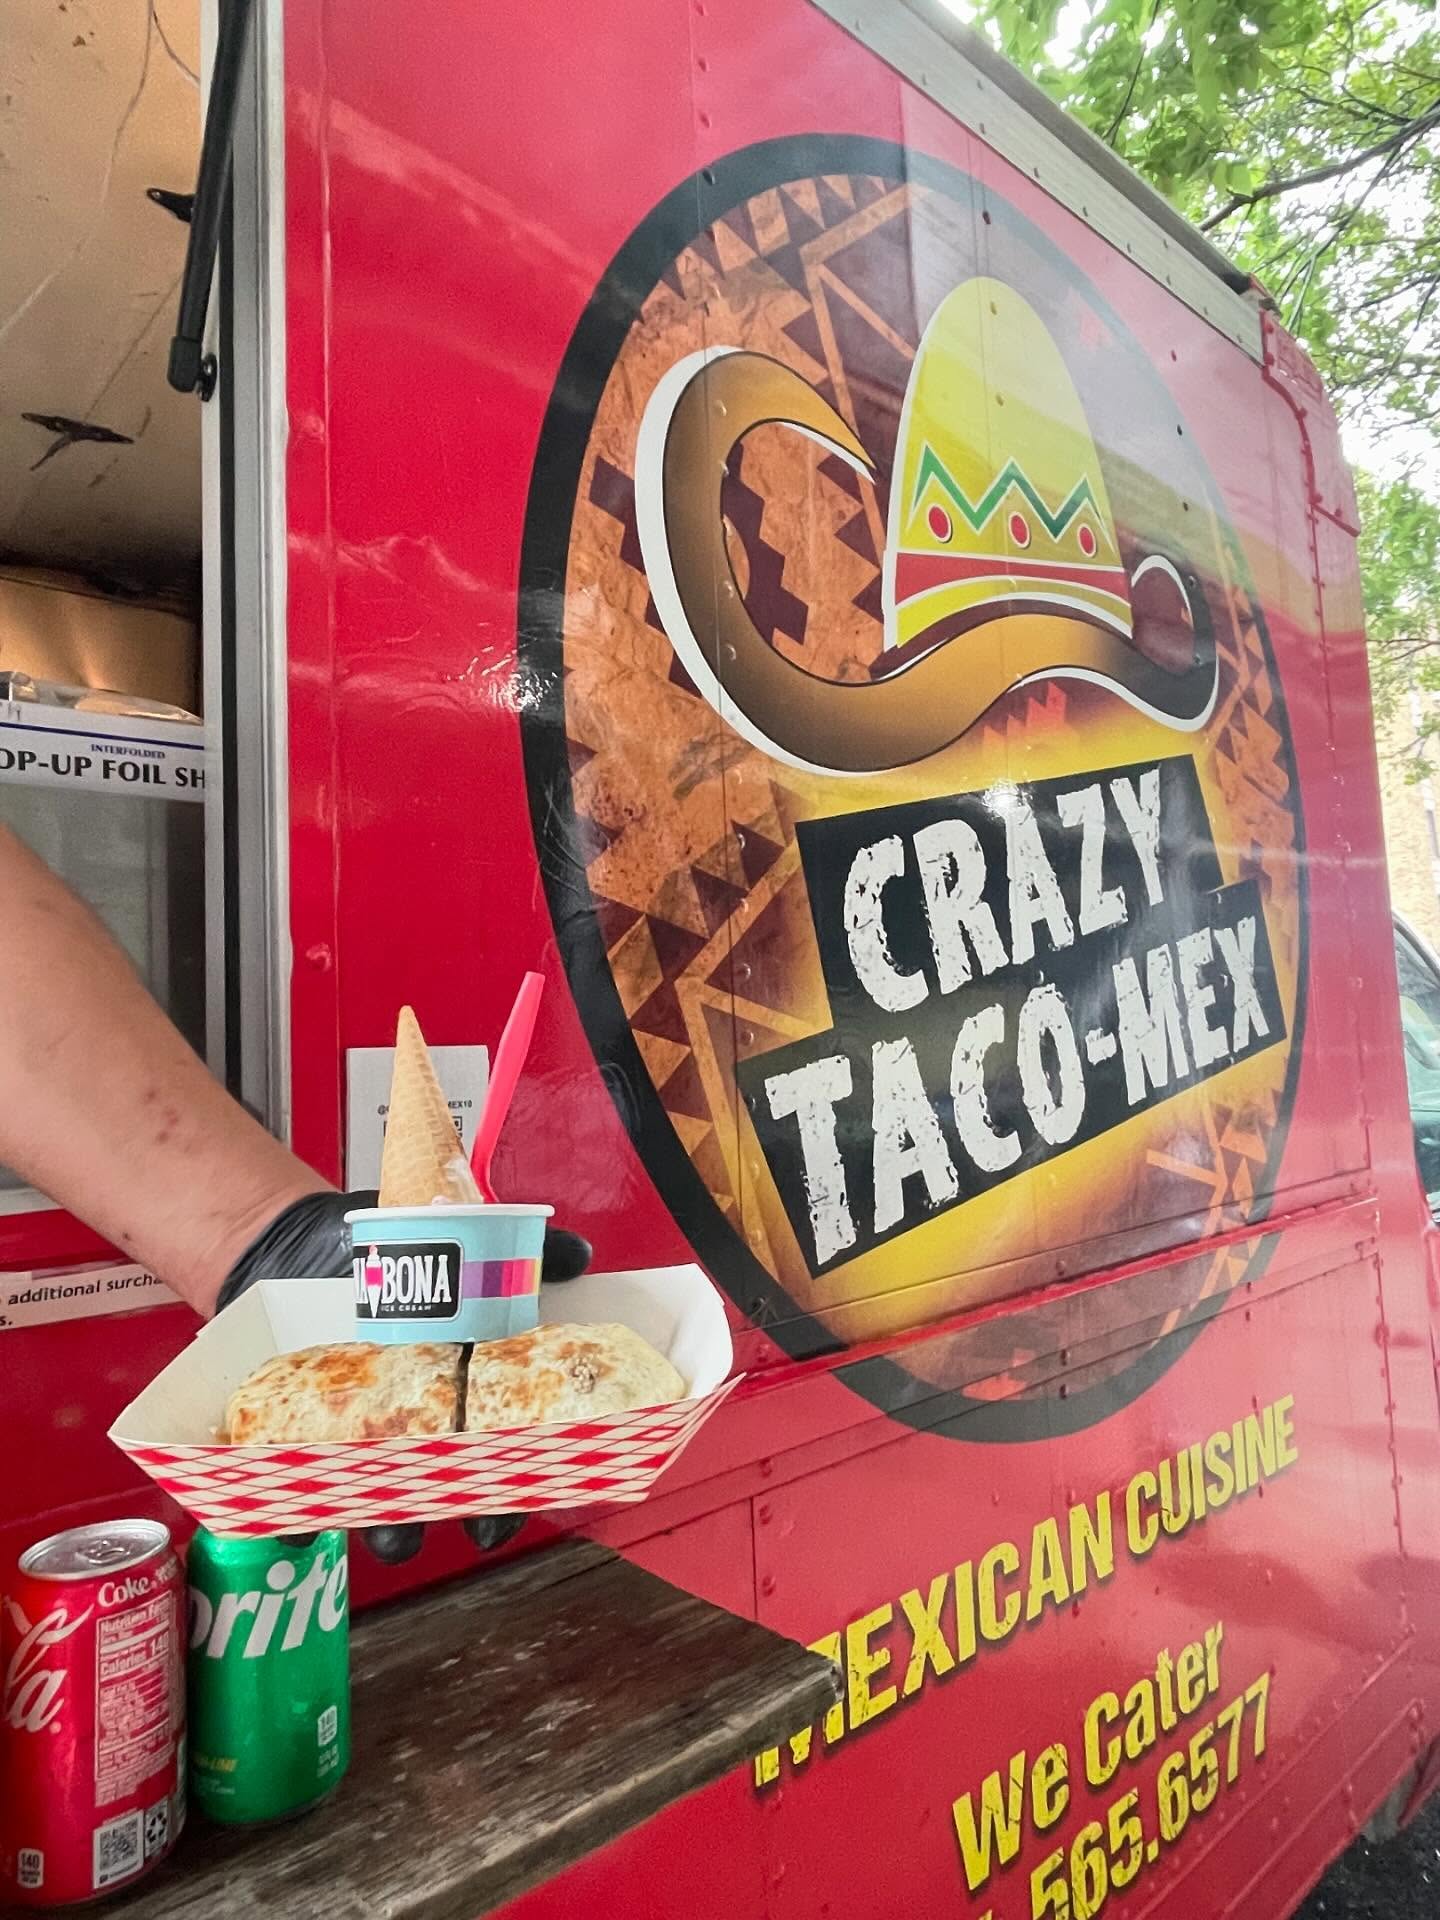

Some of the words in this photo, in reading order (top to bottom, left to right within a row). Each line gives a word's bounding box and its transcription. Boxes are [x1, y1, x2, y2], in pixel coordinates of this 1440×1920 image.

[91, 743, 166, 759] INTERFOLDED
[102, 758, 166, 785] FOIL
[843, 767, 1164, 1012] CRAZY
[763, 915, 1271, 1266] TACO-MEX
[8, 1280, 101, 1305] additional
[1125, 1393, 1300, 1556] CUISINE
[952, 1742, 1070, 1892] We
[1083, 1620, 1225, 1787] Cater
